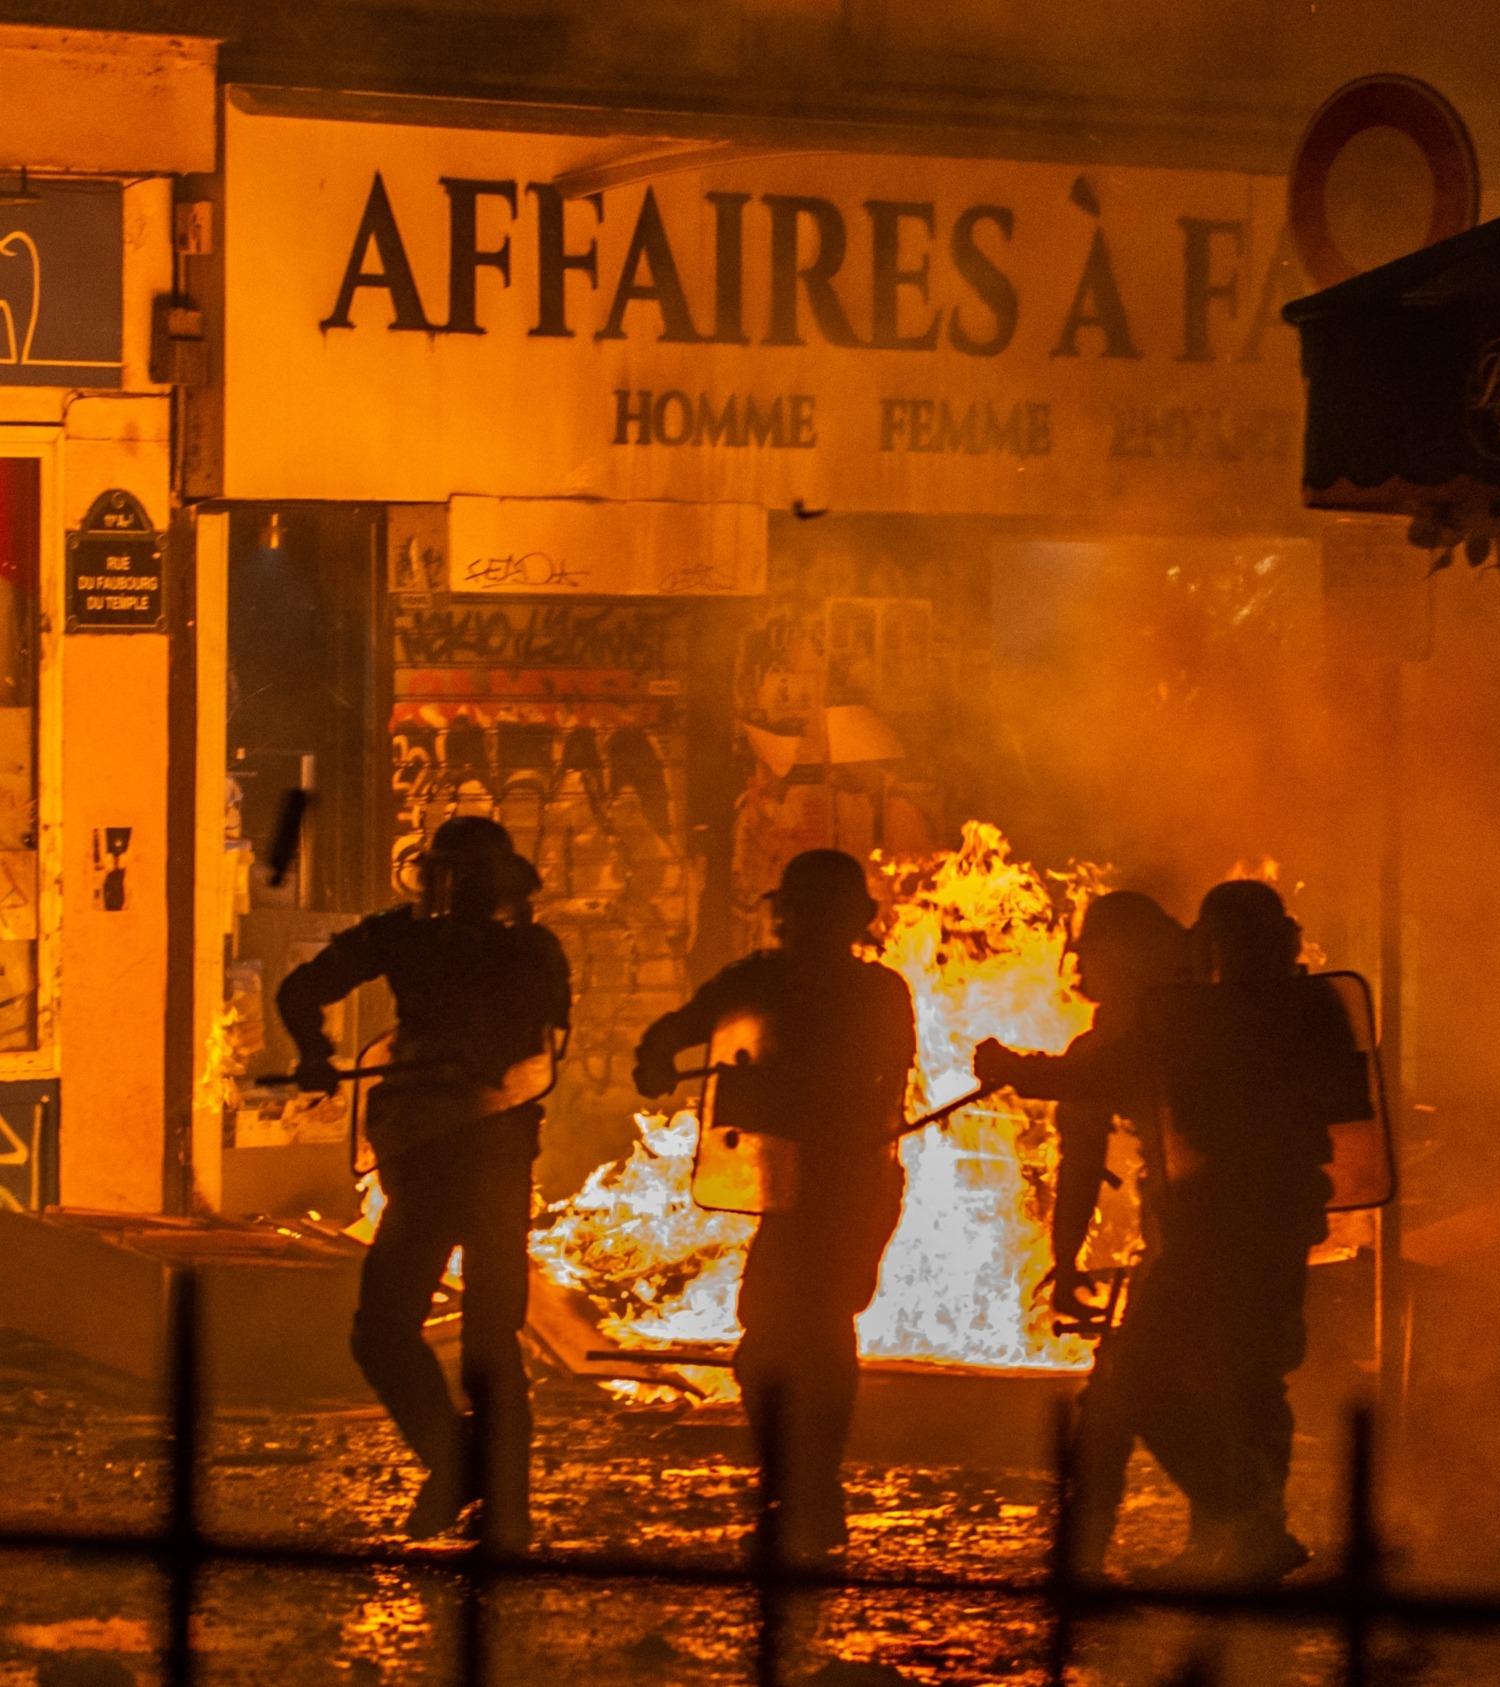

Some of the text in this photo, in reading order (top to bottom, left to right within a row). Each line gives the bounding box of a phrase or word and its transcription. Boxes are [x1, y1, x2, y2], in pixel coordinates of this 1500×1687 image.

[319, 169, 1019, 359] AFFAIRES
[1050, 174, 1143, 361] À
[611, 389, 816, 449] HOMME
[879, 398, 1052, 458] FEMME
[106, 555, 131, 570] RUE
[78, 575, 159, 591] DU FAUBOURG
[86, 595, 149, 610] DU TEMPLE
